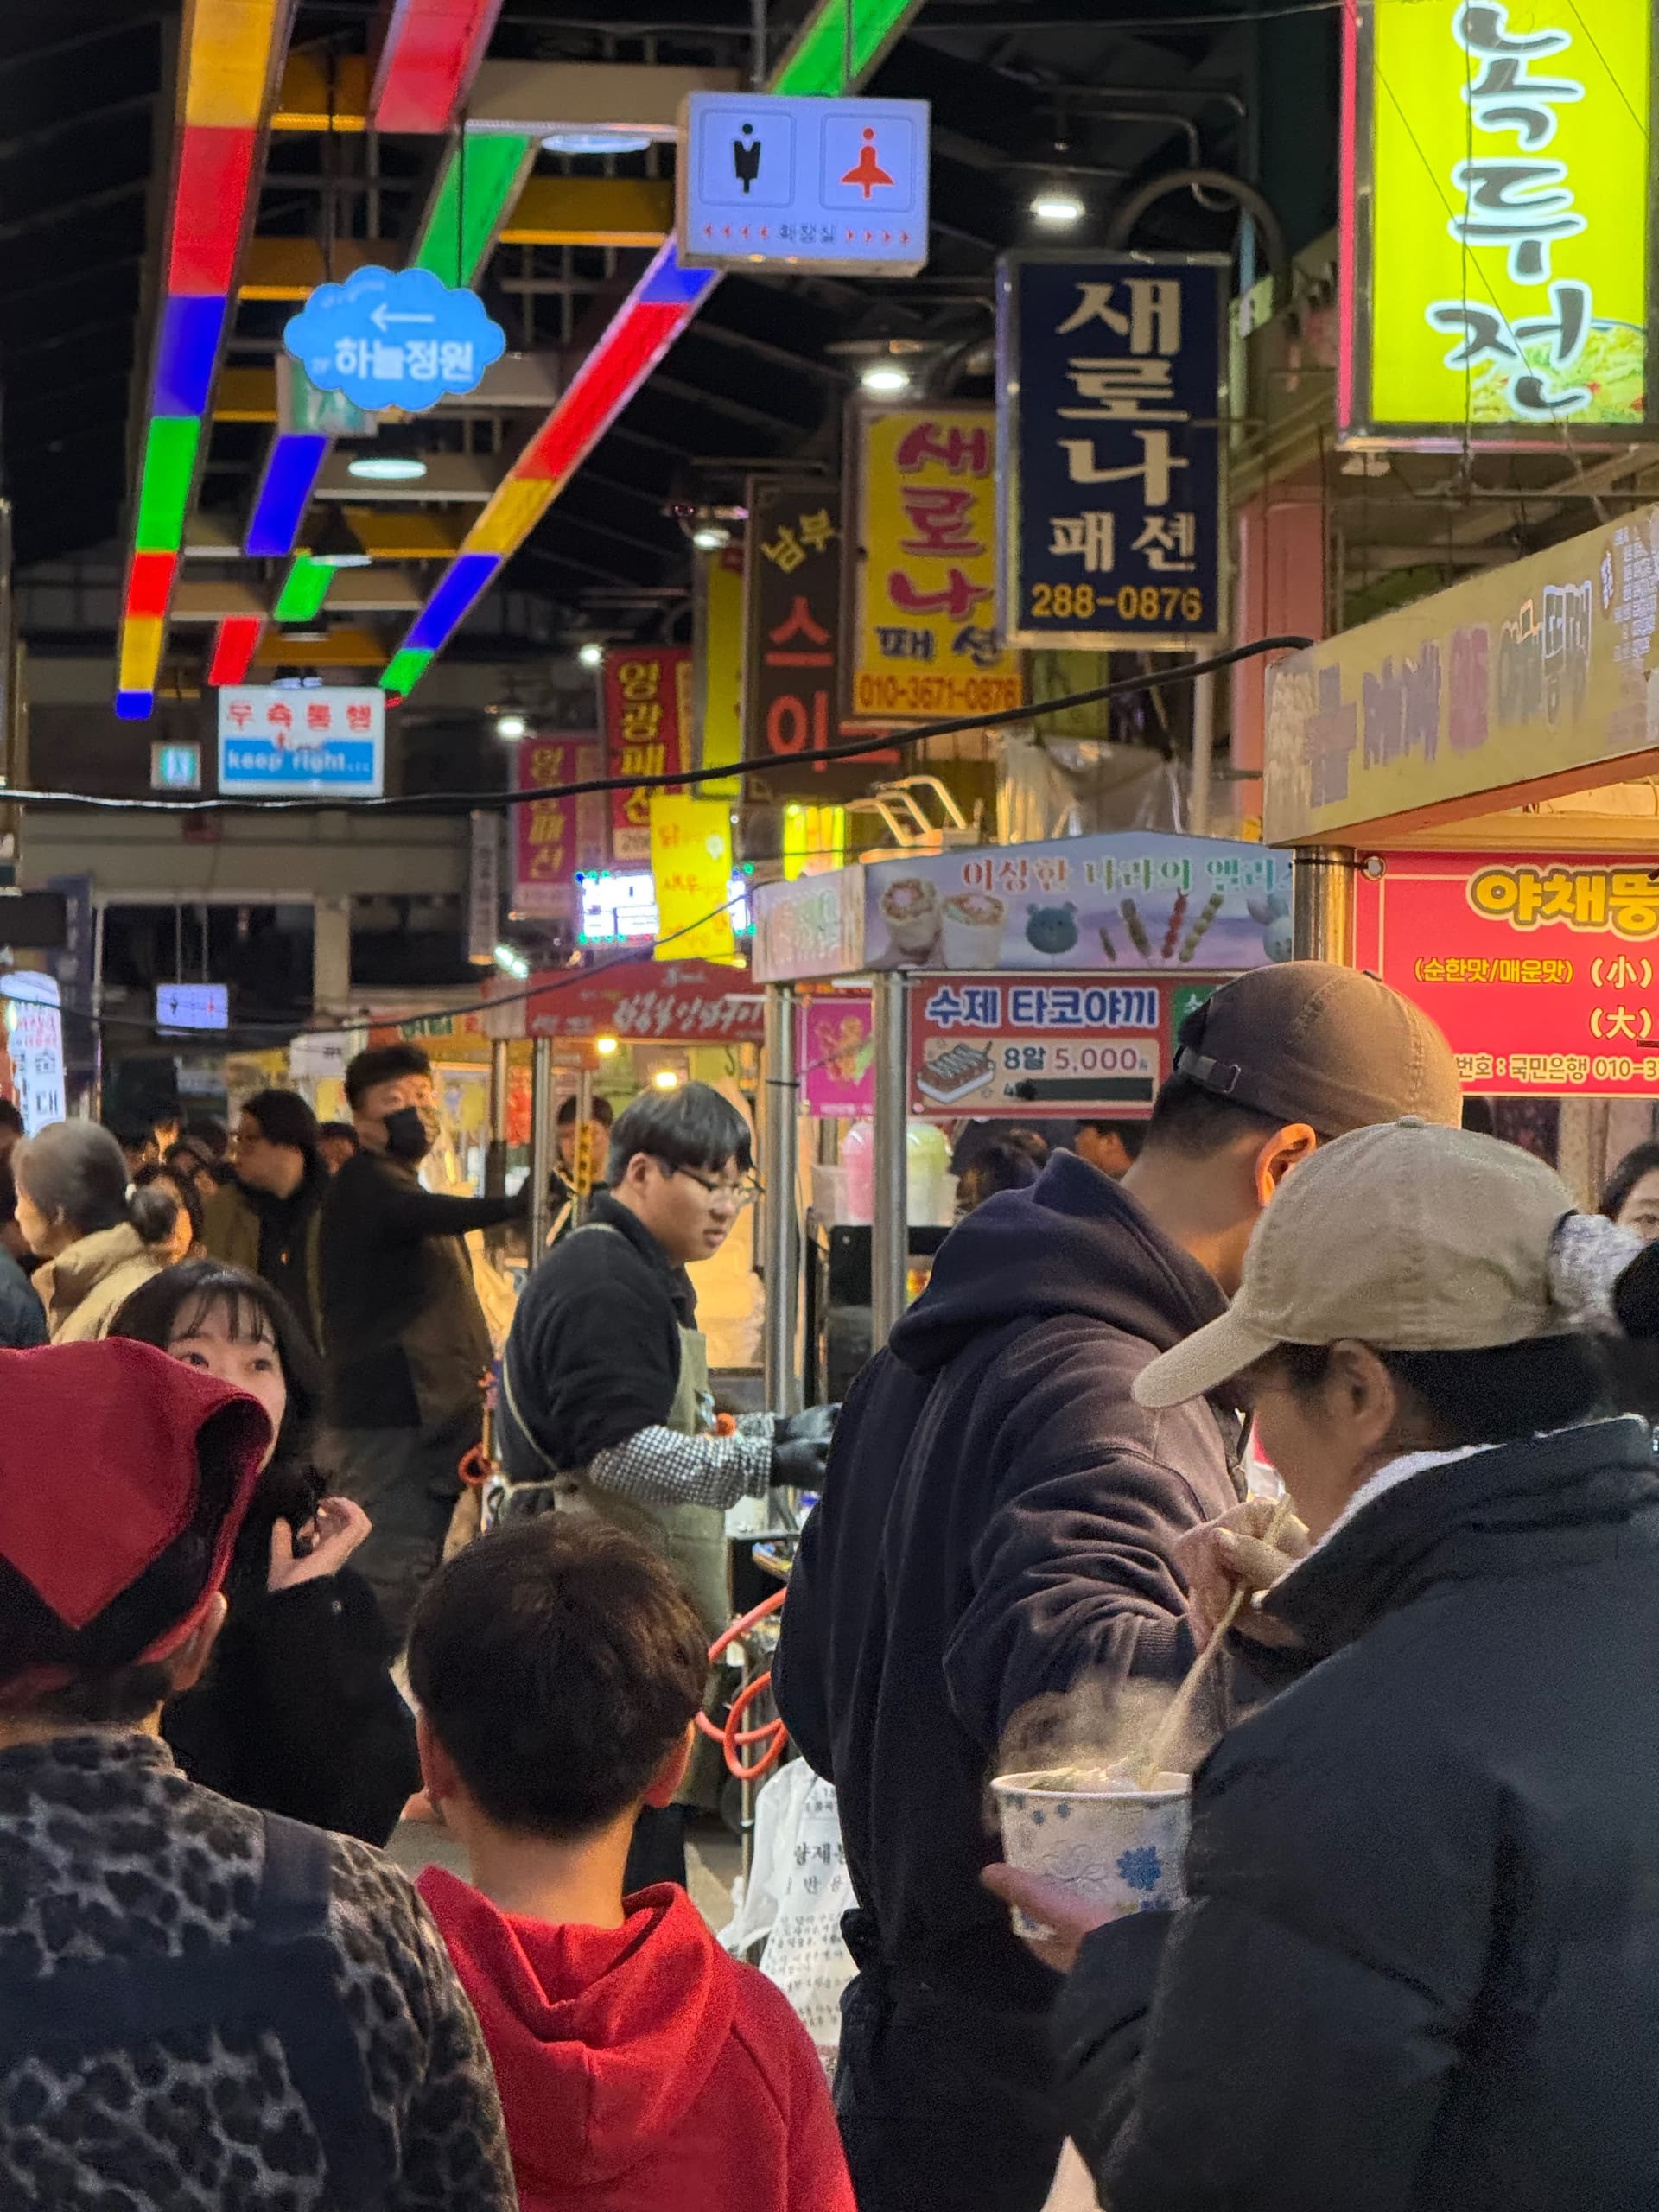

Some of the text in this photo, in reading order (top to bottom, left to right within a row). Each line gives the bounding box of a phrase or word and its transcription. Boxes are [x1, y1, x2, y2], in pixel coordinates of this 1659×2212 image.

[1426, 1, 1590, 417] 녹두전
[780, 223, 837, 244] 화장실
[334, 335, 474, 382] 하늘정원
[1055, 277, 1191, 508] 새로나
[888, 422, 995, 619] 새로나
[1048, 510, 1198, 574] 패션
[1032, 582, 1203, 621] 288-0876
[226, 749, 283, 772] keep
[963, 858, 1069, 892] 이상한
[1084, 857, 1191, 892] 나라의
[1414, 953, 1654, 990] (순한맛/매운맛) (小)
[926, 987, 1000, 1027] 수제
[1008, 987, 1159, 1027] 타코야끼
[1588, 1004, 1654, 1040] (大)
[1003, 1046, 1047, 1071] 8알
[1510, 1056, 1588, 1082] 국민은행
[1594, 1058, 1659, 1079] 010-3
